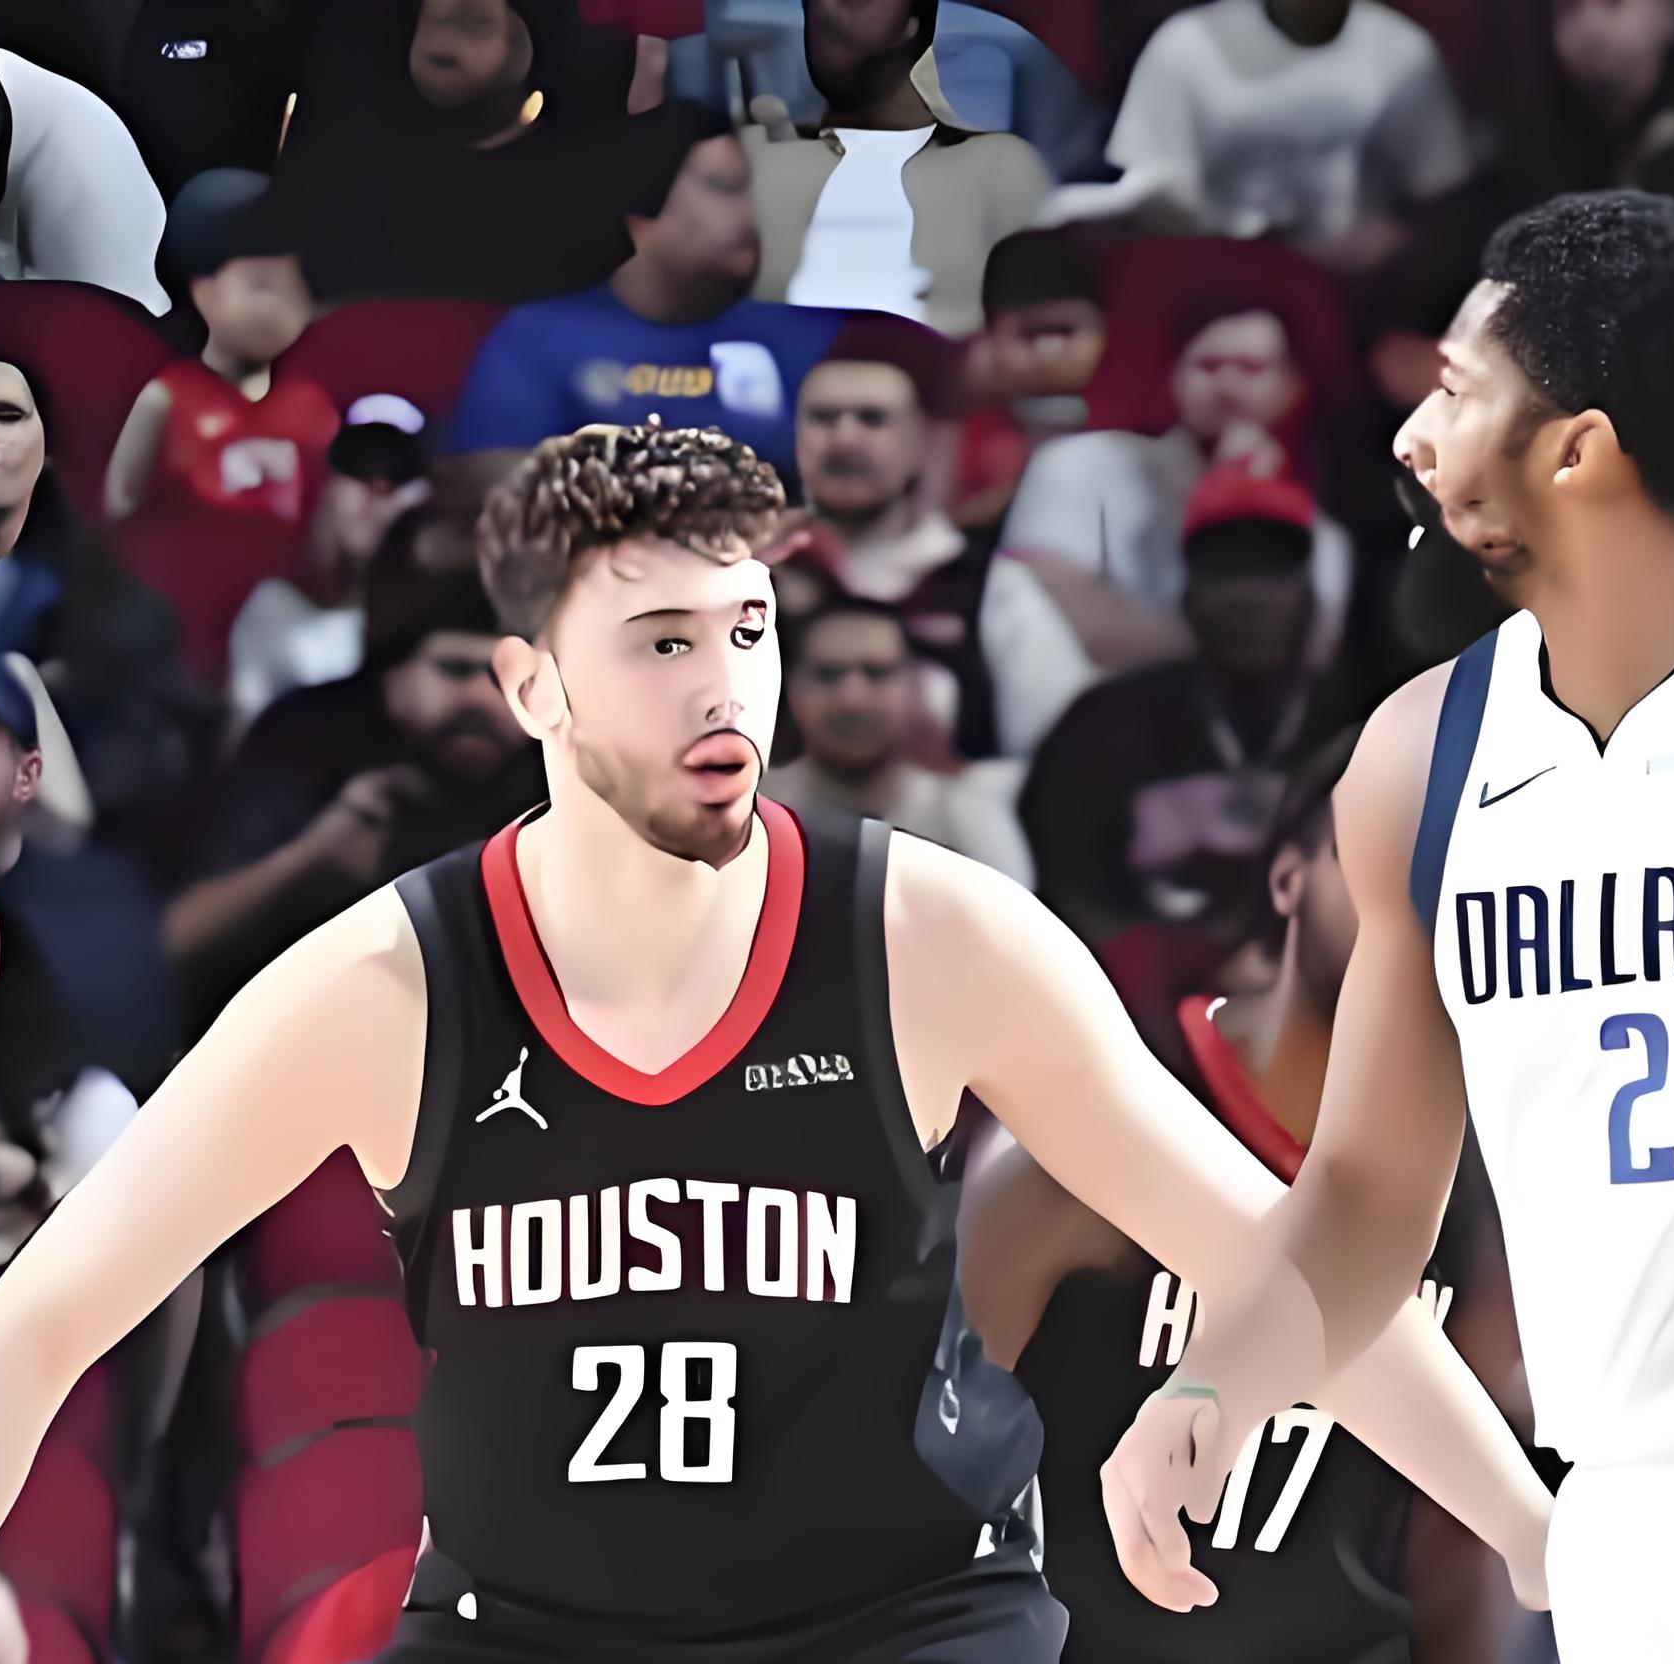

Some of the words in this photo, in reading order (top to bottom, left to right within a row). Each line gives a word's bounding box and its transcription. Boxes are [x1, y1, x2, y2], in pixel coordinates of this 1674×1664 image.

[452, 1177, 857, 1308] HOUSTON
[567, 1341, 737, 1483] 28
[1211, 1407, 1335, 1553] 17
